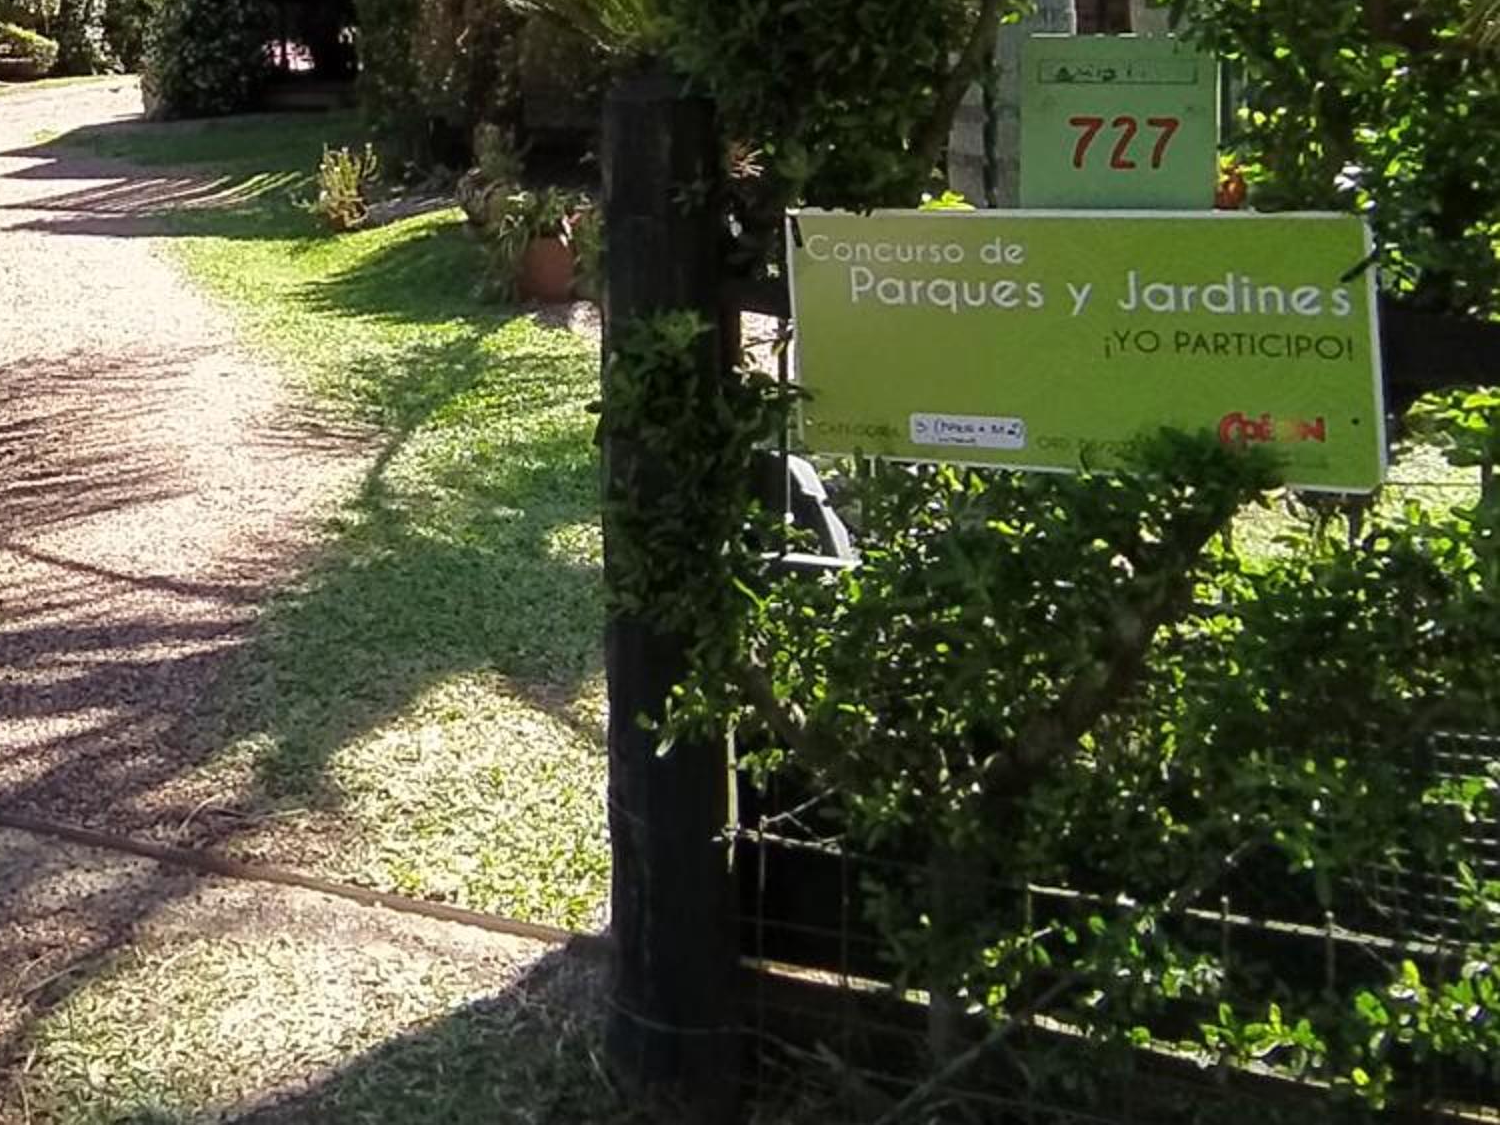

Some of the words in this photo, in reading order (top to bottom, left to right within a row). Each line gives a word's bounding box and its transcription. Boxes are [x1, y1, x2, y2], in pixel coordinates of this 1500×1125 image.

[1068, 115, 1181, 170] 727
[805, 233, 965, 264] Concurso
[979, 236, 1026, 265] de
[850, 265, 1045, 315] Parques
[1065, 281, 1093, 317] y
[1117, 269, 1352, 317] Jardines
[1173, 330, 1354, 362] PARTICIPO!
